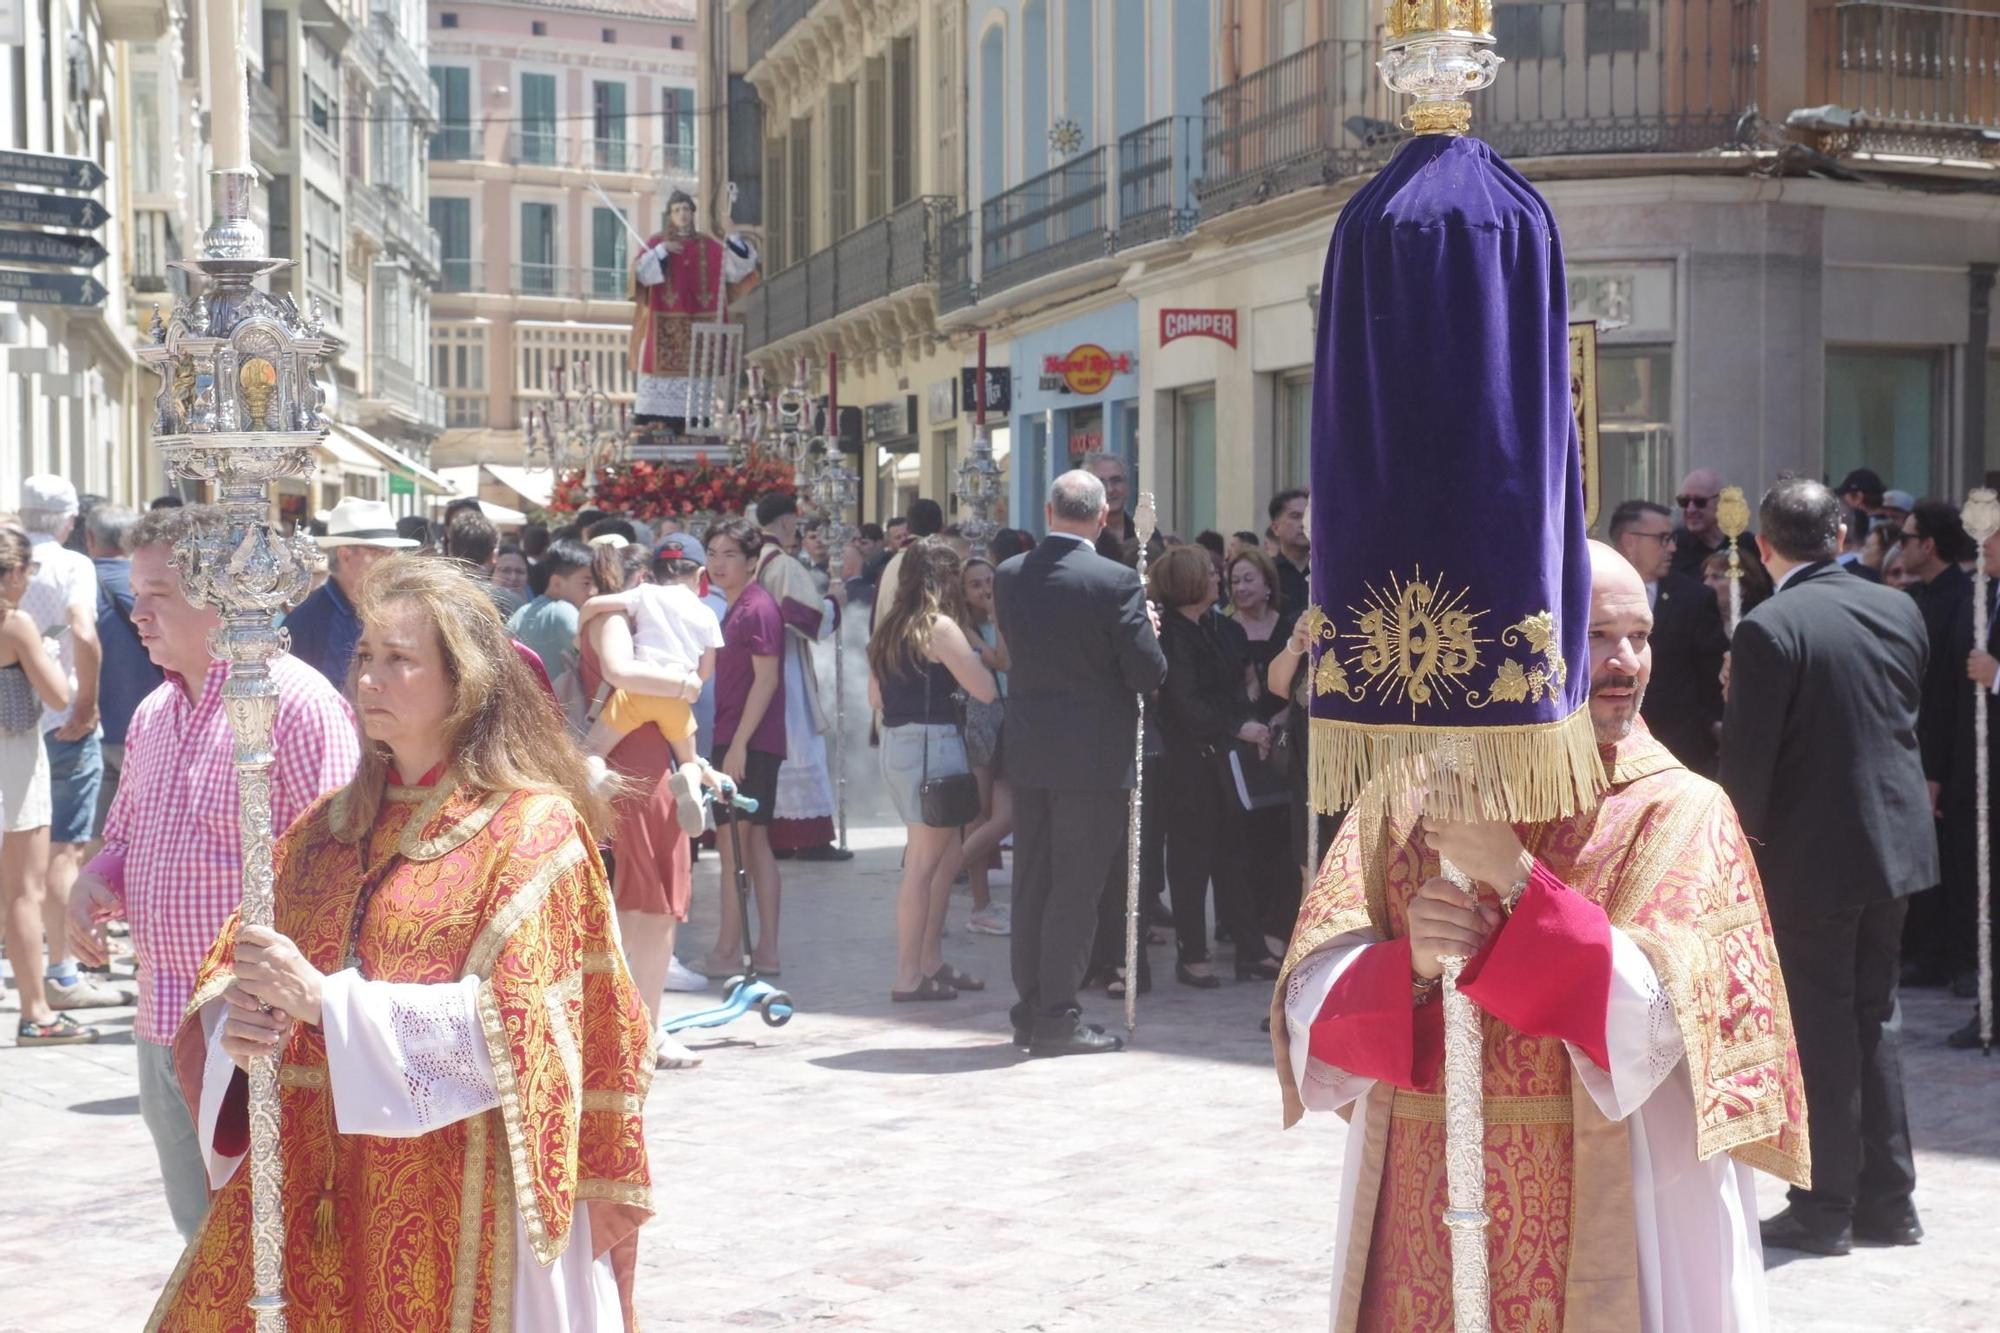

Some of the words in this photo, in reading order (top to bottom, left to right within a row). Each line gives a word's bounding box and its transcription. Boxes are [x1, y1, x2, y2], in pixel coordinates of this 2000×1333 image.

[1165, 313, 1233, 339] CAMPER
[1044, 353, 1088, 374] Hard
[1090, 352, 1130, 375] Rock
